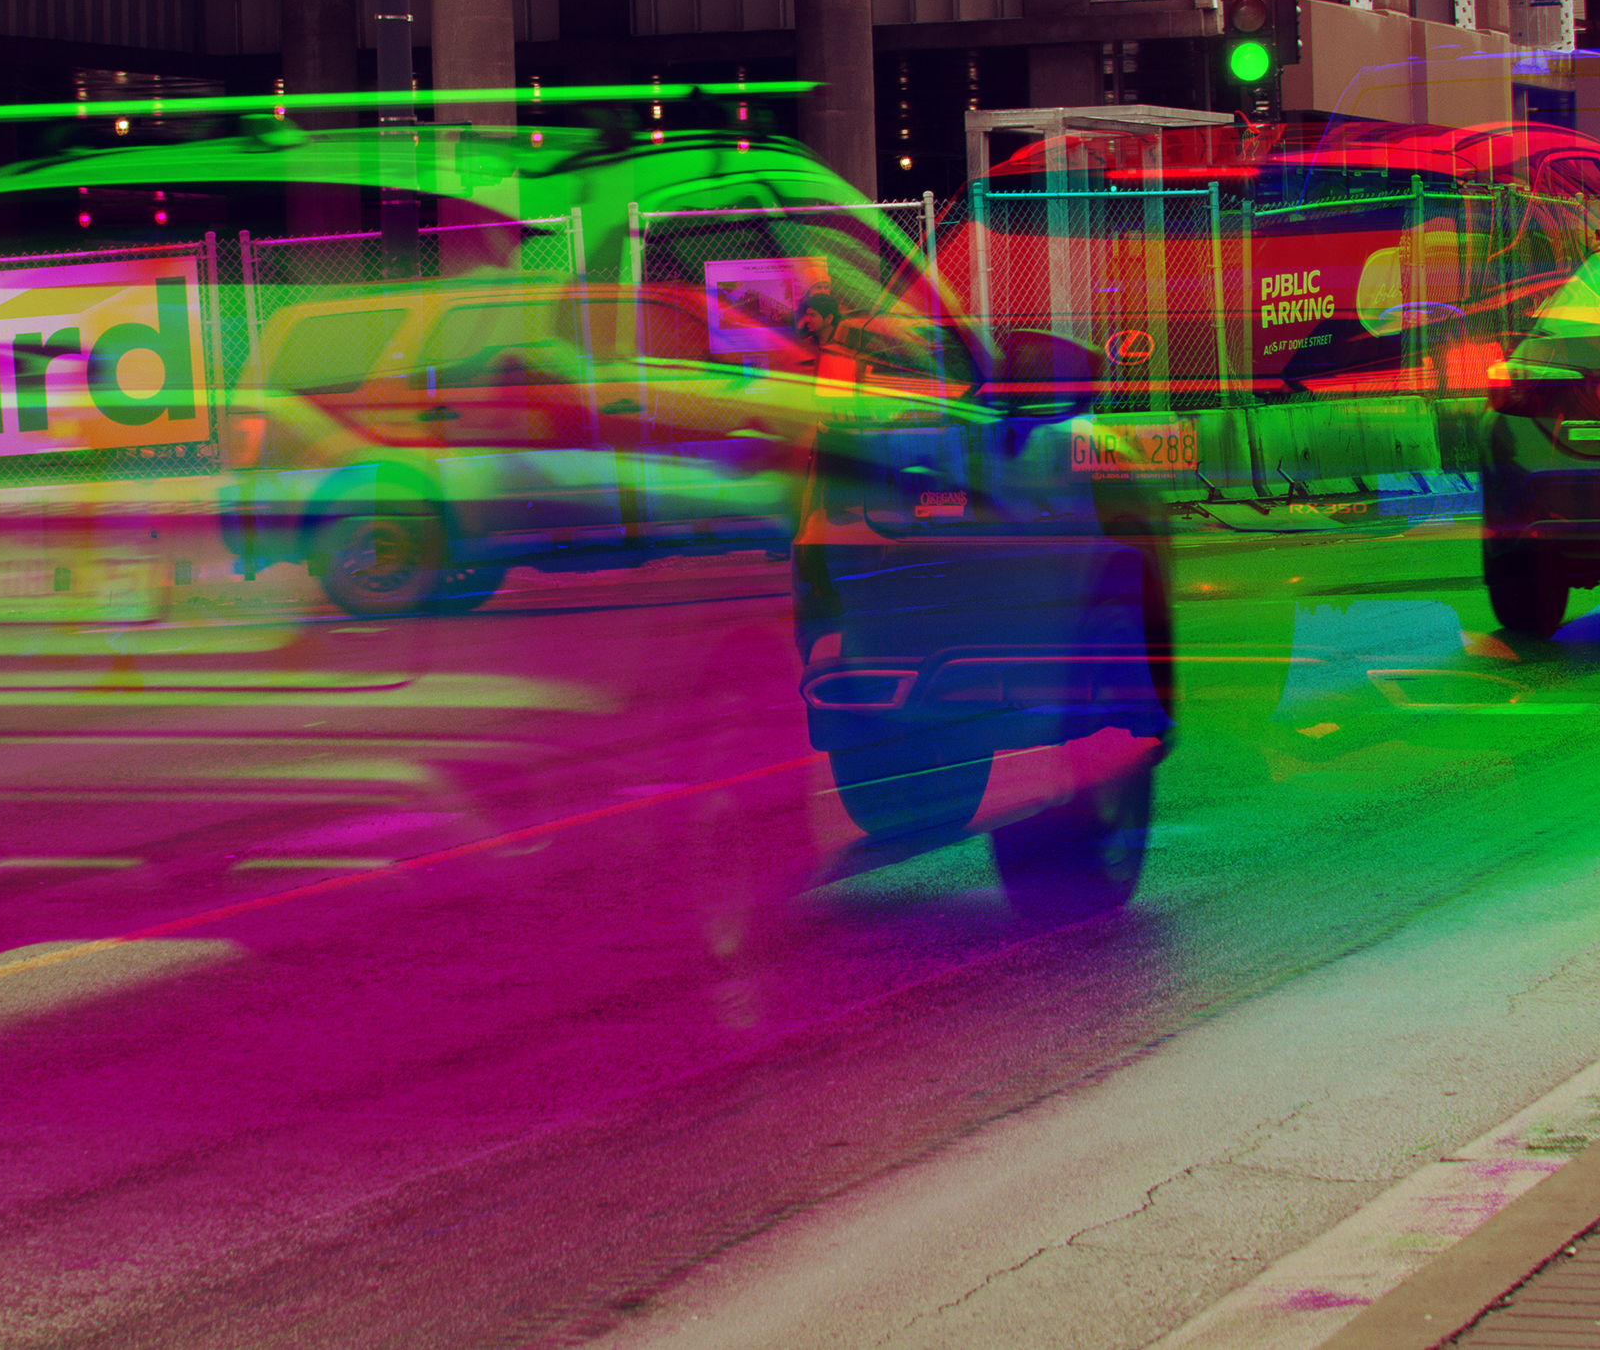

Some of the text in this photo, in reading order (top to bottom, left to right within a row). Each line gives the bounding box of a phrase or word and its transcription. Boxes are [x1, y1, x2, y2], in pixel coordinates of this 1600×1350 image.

[1288, 336, 1308, 351] DOYLE
[1309, 334, 1333, 347] STREET
[1073, 434, 1194, 464] GNR 288
[1289, 502, 1368, 515] RX 350
